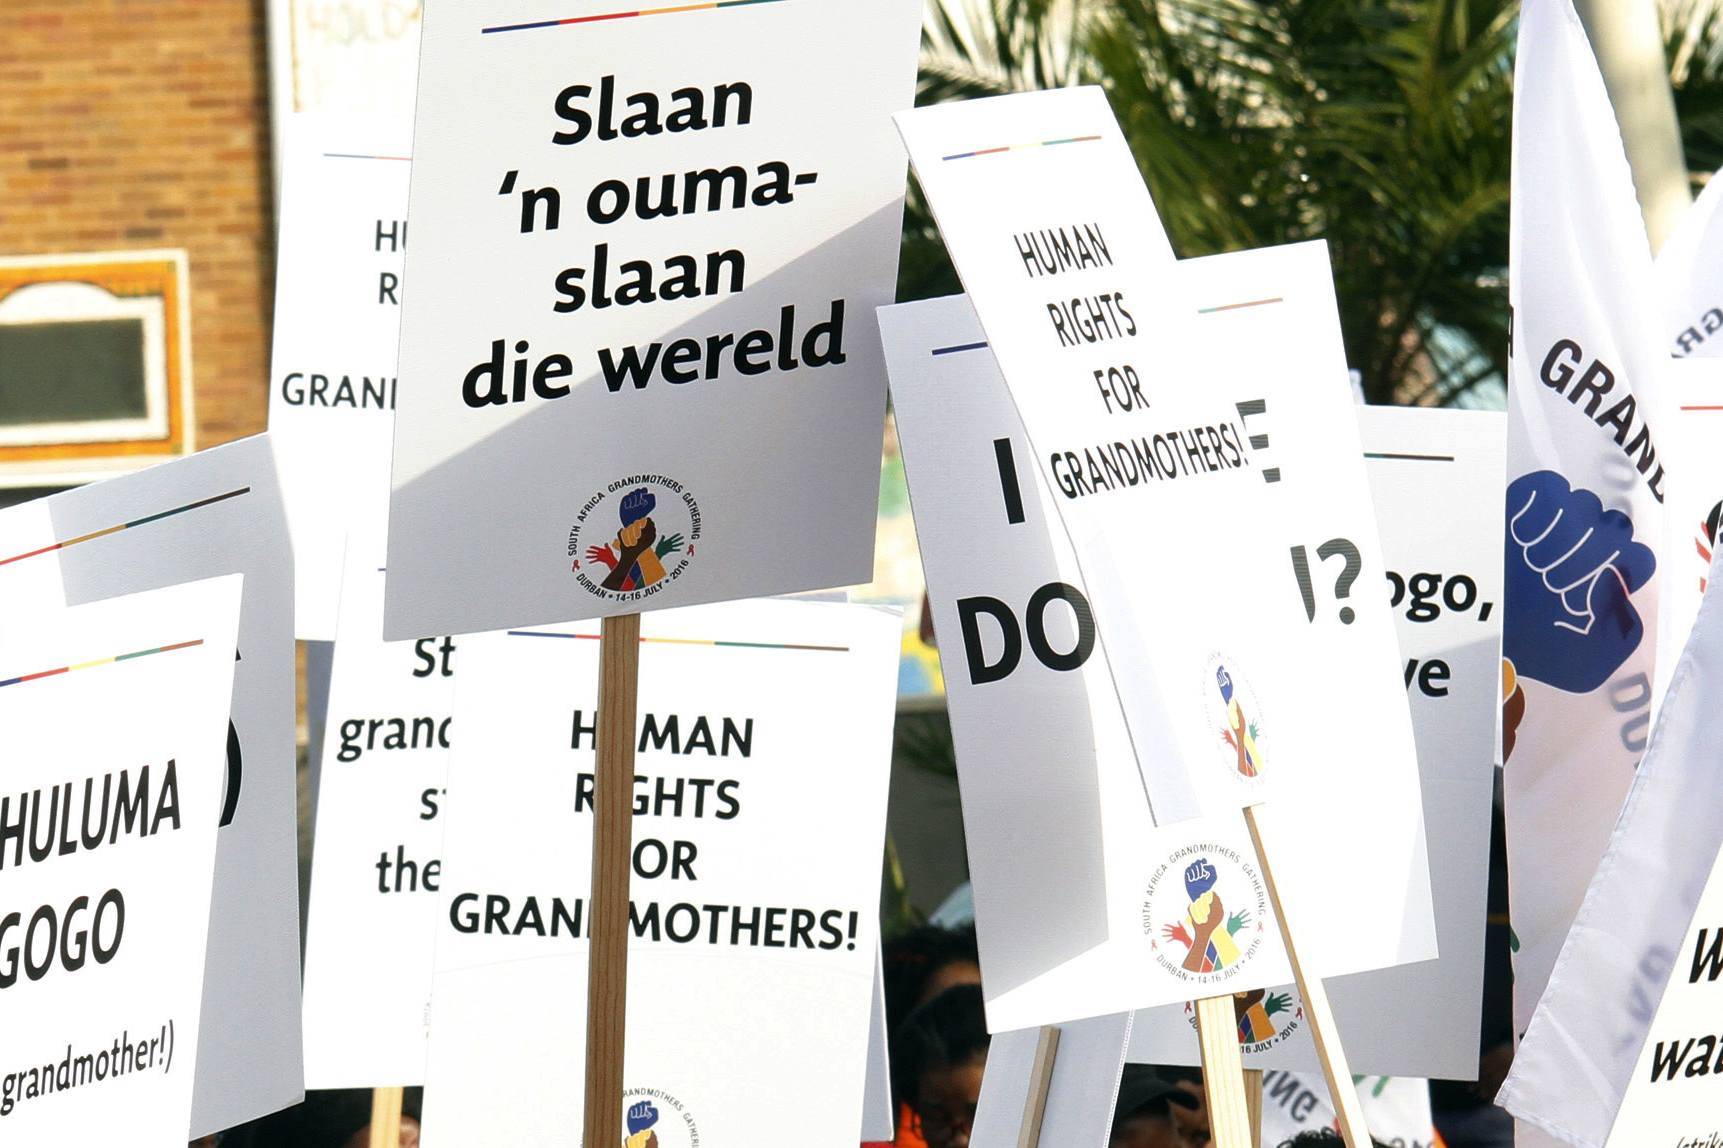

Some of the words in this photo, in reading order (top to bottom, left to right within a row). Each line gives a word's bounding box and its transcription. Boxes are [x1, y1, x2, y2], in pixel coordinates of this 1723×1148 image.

[551, 75, 753, 146] Slaan
[585, 153, 821, 225] ouma-
[1012, 222, 1114, 279] HUMAN
[552, 244, 745, 314] slaan
[1046, 291, 1137, 349] RIGHTS
[462, 339, 573, 410] die
[597, 300, 847, 394] wereld
[1094, 364, 1151, 415] FOR
[993, 437, 1026, 526] I
[1049, 420, 1250, 501] GRANDMOTHERS!
[568, 525, 581, 556] SOUTH
[577, 492, 606, 522] AFRICA
[608, 474, 683, 493] GRANDMOTHERS
[682, 492, 702, 540] GATHERING
[576, 573, 607, 599] DURBAN
[615, 591, 641, 602] 14-16
[643, 582, 664, 598] JULY
[670, 559, 689, 580] 2016
[956, 581, 1097, 686] DO
[569, 708, 755, 759] HMAN
[573, 772, 743, 822] RGHTS
[630, 838, 700, 882] OR
[1146, 863, 1168, 896] AFRICA
[1170, 843, 1241, 863] GRANDMOTHERS
[1242, 863, 1266, 915] GATHERING
[447, 891, 860, 952] GRANMOTHERS!
[1142, 901, 1153, 935] SOUTH
[1156, 954, 1188, 982] DURBAN
[1197, 975, 1221, 984] 14-16
[1224, 964, 1240, 980] JULY
[1246, 938, 1261, 959] 2016
[1253, 1039, 1272, 1054] JULY
[1279, 1020, 1299, 1040] 2016
[0, 1019, 176, 1118] grandmother!)
[622, 1088, 684, 1112] RANDMOTHERS
